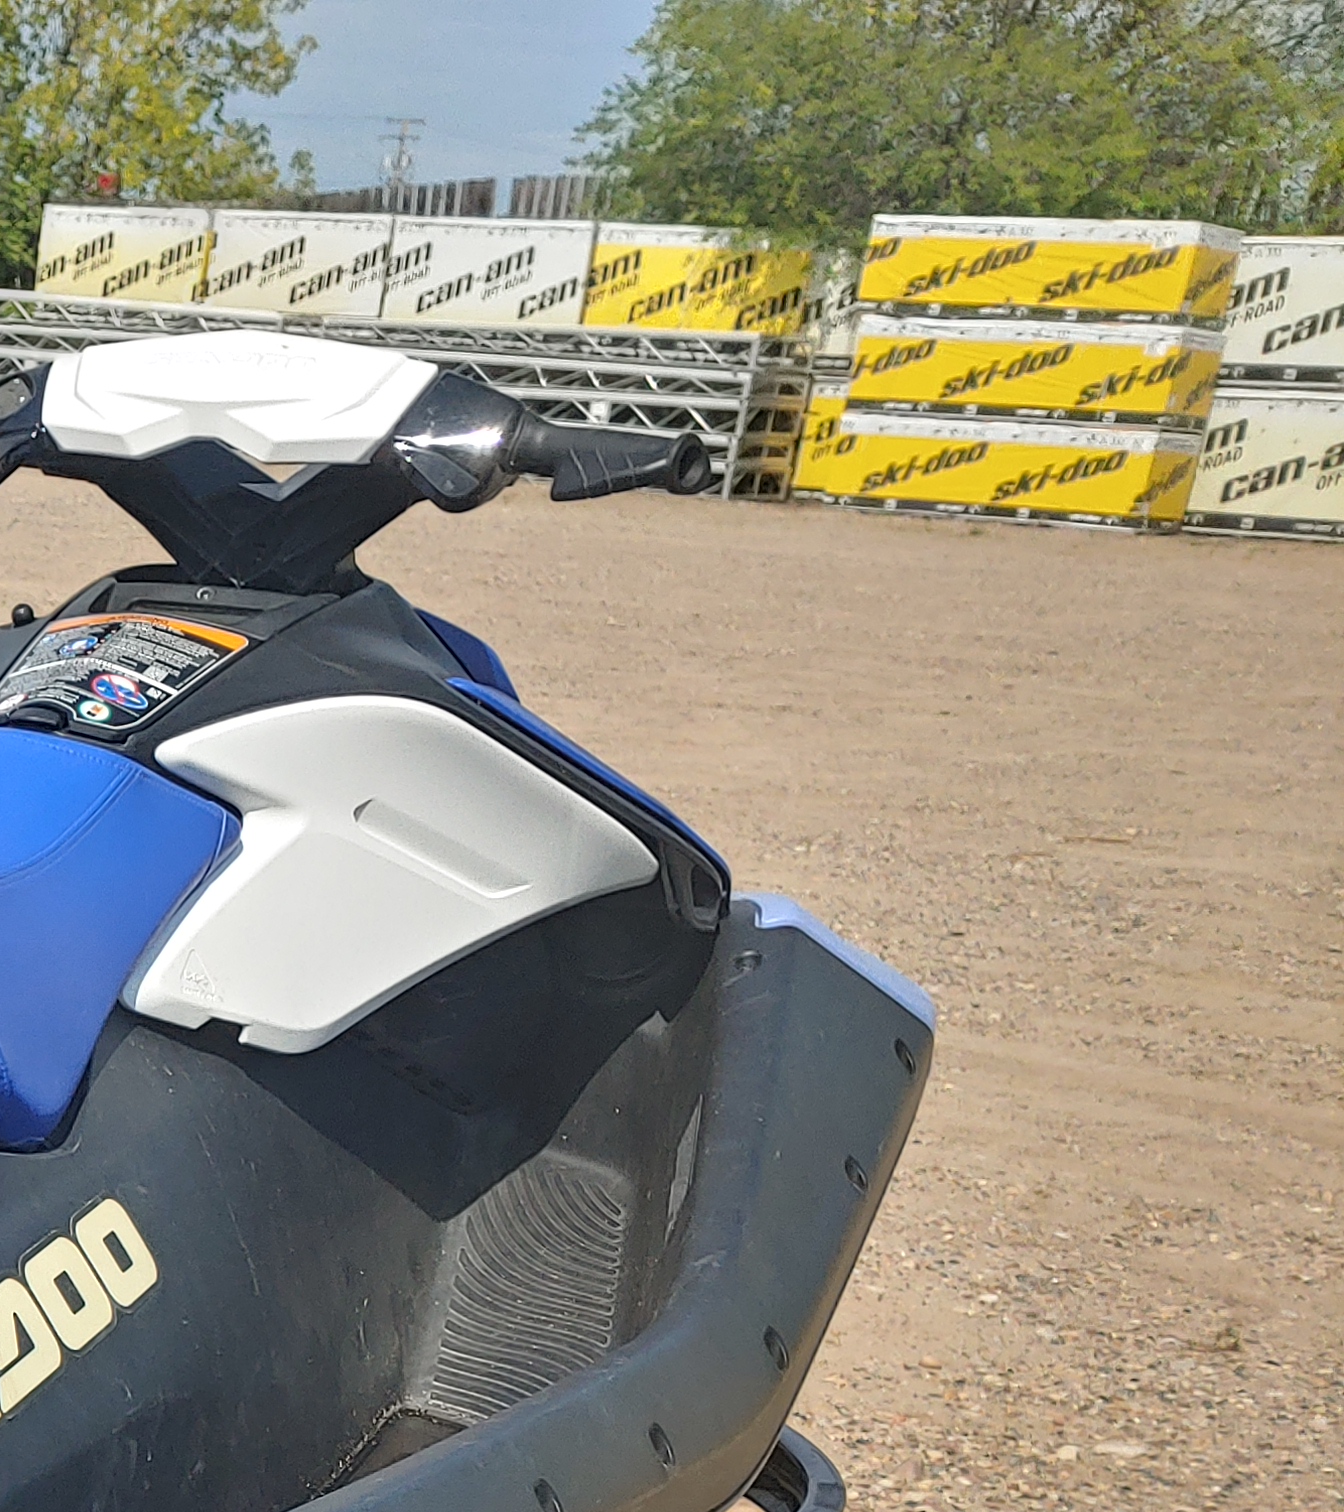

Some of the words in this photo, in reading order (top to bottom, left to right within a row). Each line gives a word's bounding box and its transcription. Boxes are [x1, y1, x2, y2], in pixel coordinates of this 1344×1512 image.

[416, 245, 535, 313] can-am
[903, 241, 1037, 297] ski-doo
[1039, 245, 1181, 302] ski-doo
[940, 343, 1075, 398] ski-doo
[860, 441, 988, 492] ski-doo
[991, 450, 1130, 501] ski-doo
